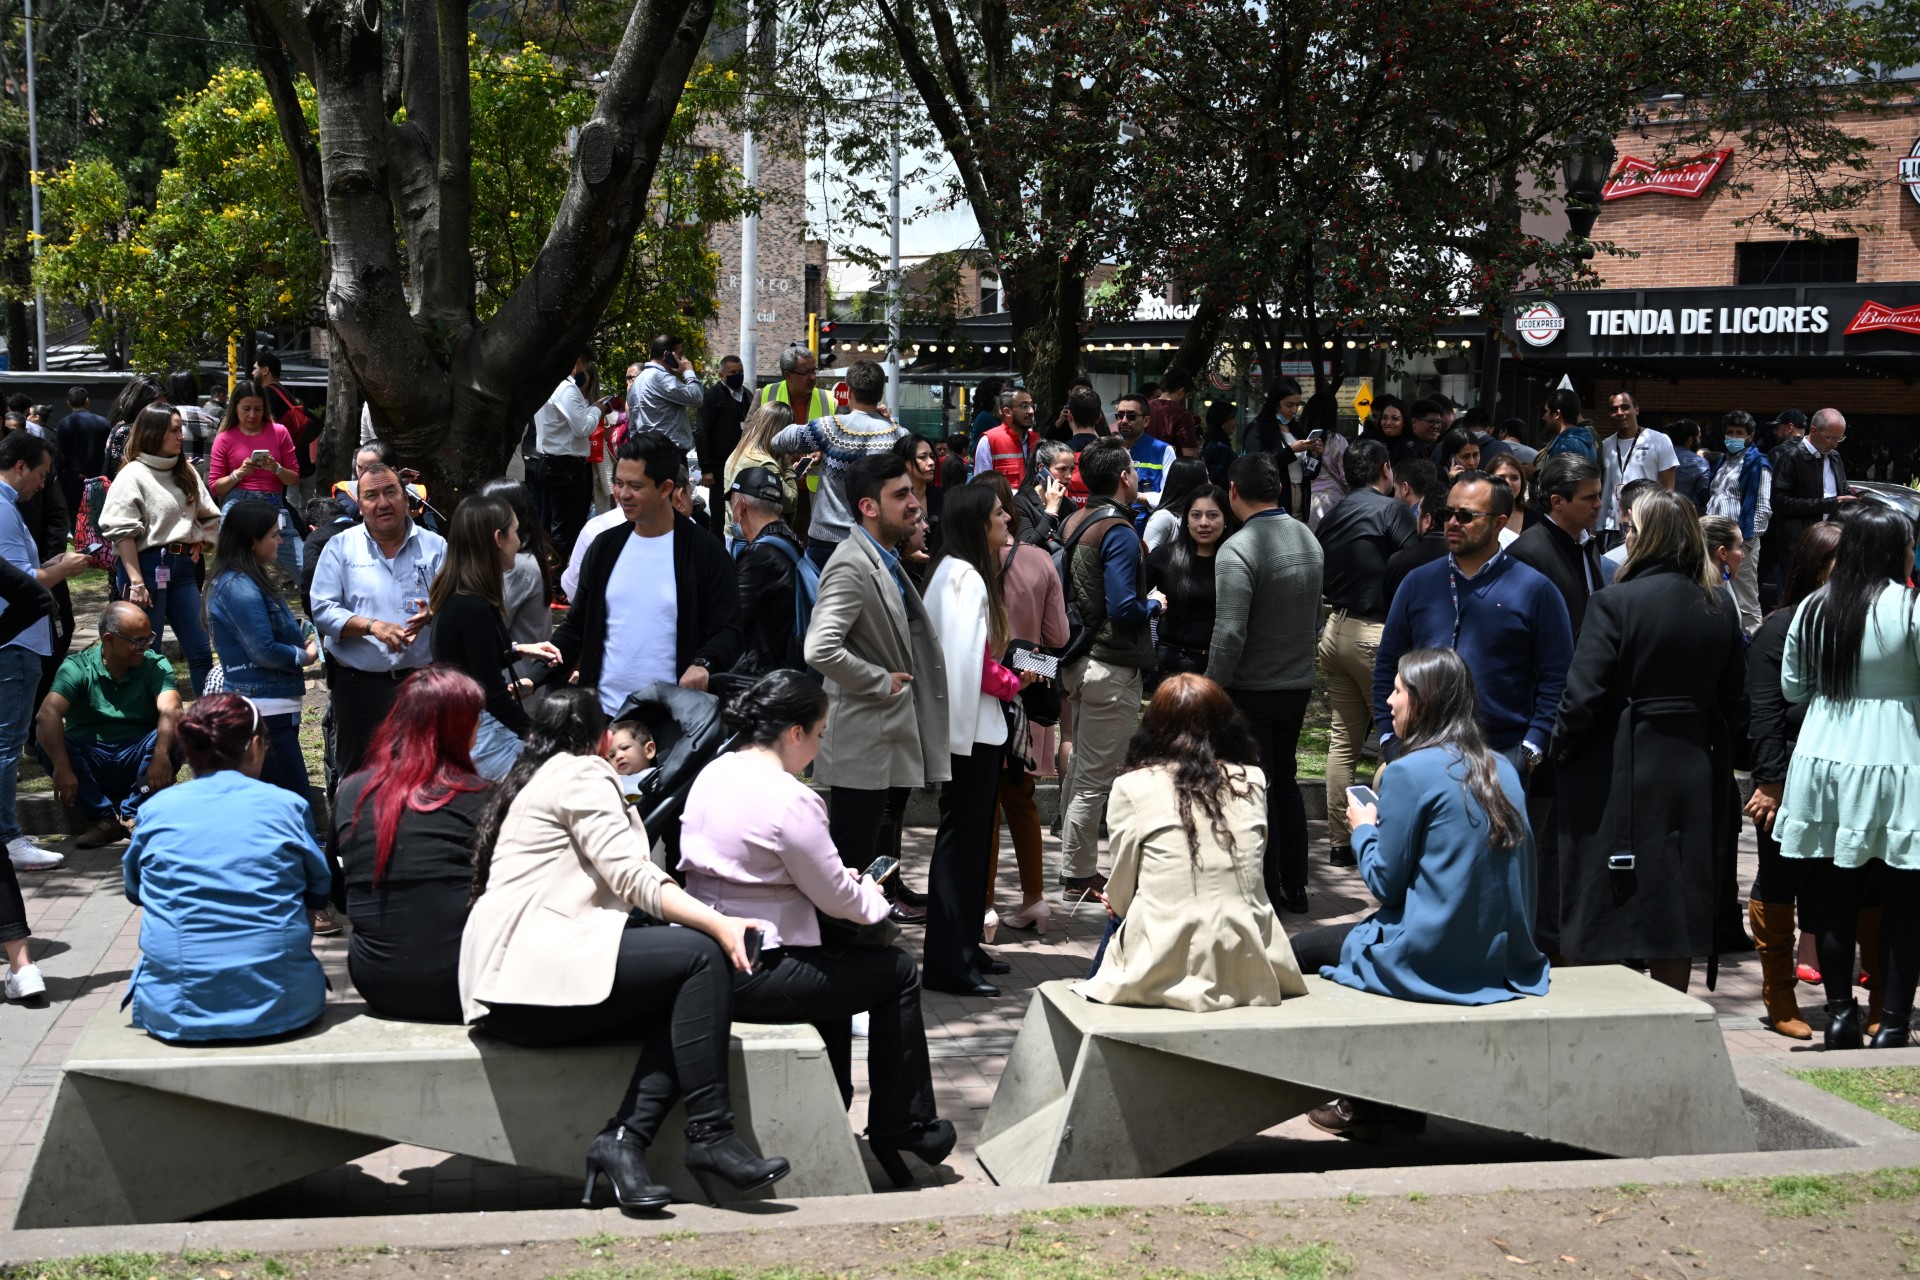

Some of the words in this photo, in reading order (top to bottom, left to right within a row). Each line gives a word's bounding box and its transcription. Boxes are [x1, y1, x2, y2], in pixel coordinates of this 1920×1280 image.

[1618, 167, 1709, 187] Bdweiser
[1902, 161, 1920, 178] LI
[729, 275, 788, 292] RMEO
[757, 309, 776, 323] cial
[1517, 319, 1563, 328] LICOEXPRESS
[1587, 309, 1675, 335] TIENDA
[1680, 308, 1713, 334] DE
[1719, 305, 1829, 334] LICORES
